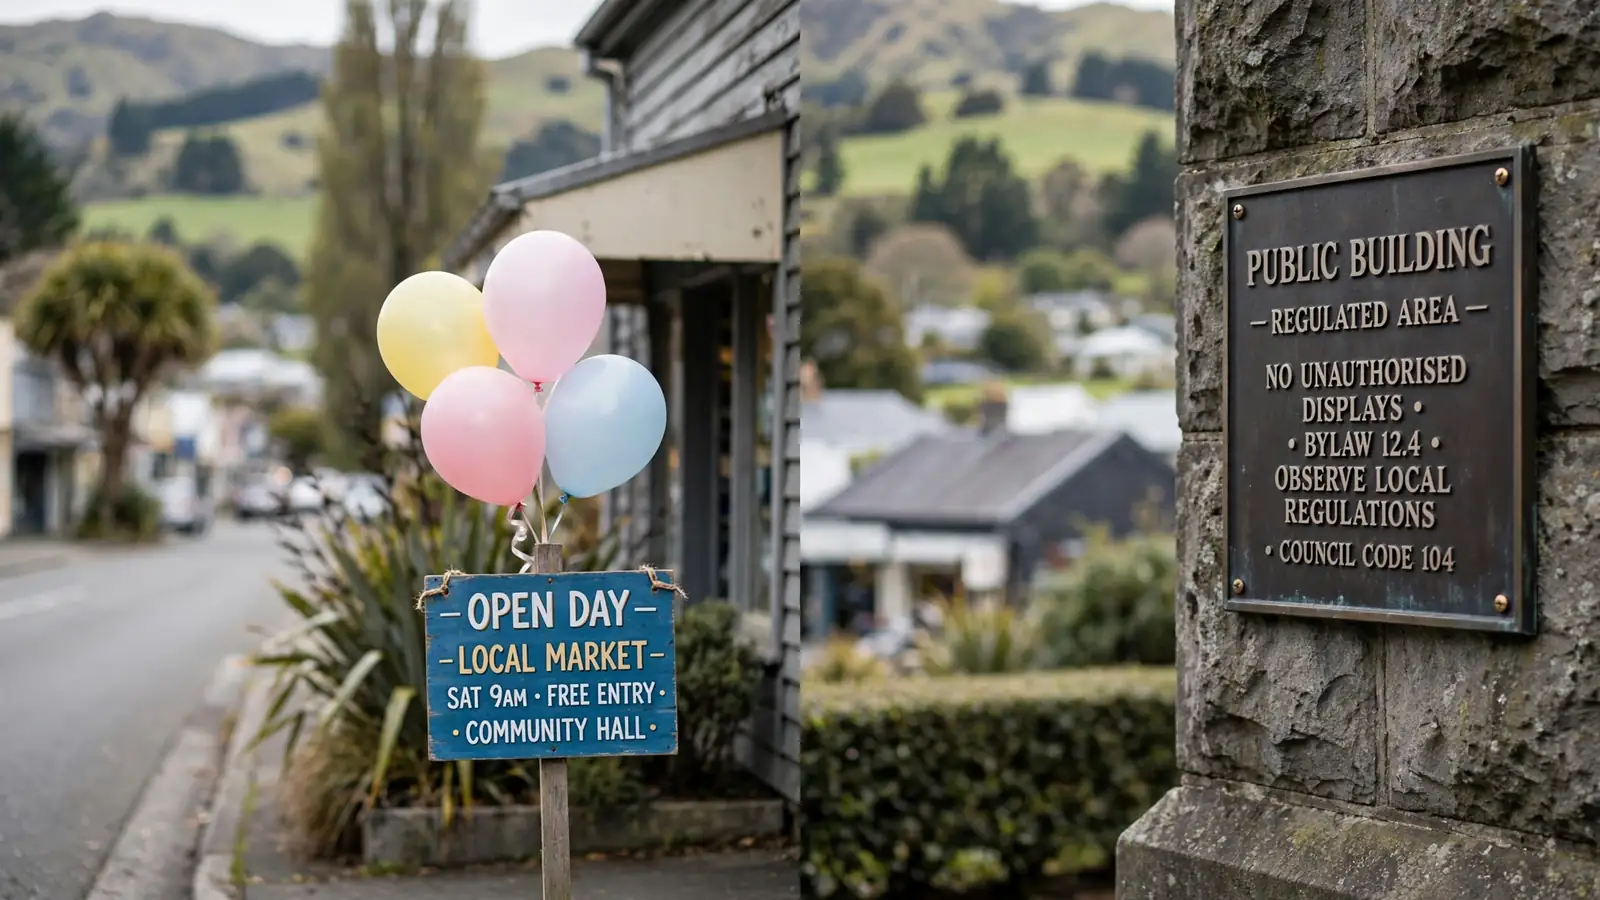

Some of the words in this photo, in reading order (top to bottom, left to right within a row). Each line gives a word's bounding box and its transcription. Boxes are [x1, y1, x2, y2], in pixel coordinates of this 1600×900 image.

[1246, 241, 1339, 286] PUBLIC
[1350, 224, 1492, 278] BUILDING
[1271, 301, 1388, 335] REGULATED
[1397, 295, 1460, 327] AREA
[1265, 362, 1292, 390] NO
[1301, 355, 1467, 389] UNAUTHORISED
[1302, 394, 1403, 423] DISPLAYS
[1304, 431, 1373, 457] BYLAW
[1381, 430, 1421, 456] 12.4
[1274, 464, 1366, 492] OBSERVE
[1375, 465, 1452, 493] LOCAL
[1284, 498, 1435, 528] REGULATIONS
[1279, 539, 1356, 567] COUNCIL
[1362, 542, 1413, 569] CODE
[1421, 545, 1455, 572] 104
[468, 591, 554, 630] OPEN
[569, 589, 630, 627] DAY
[459, 643, 535, 675] LOCAL
[546, 640, 648, 672] MARKET
[447, 686, 482, 709] SAT
[489, 684, 527, 708] 9AM
[547, 683, 590, 706] FREE
[597, 681, 656, 705] ENTRY
[465, 718, 588, 744] COMMUNITY
[597, 716, 646, 741] HALL
